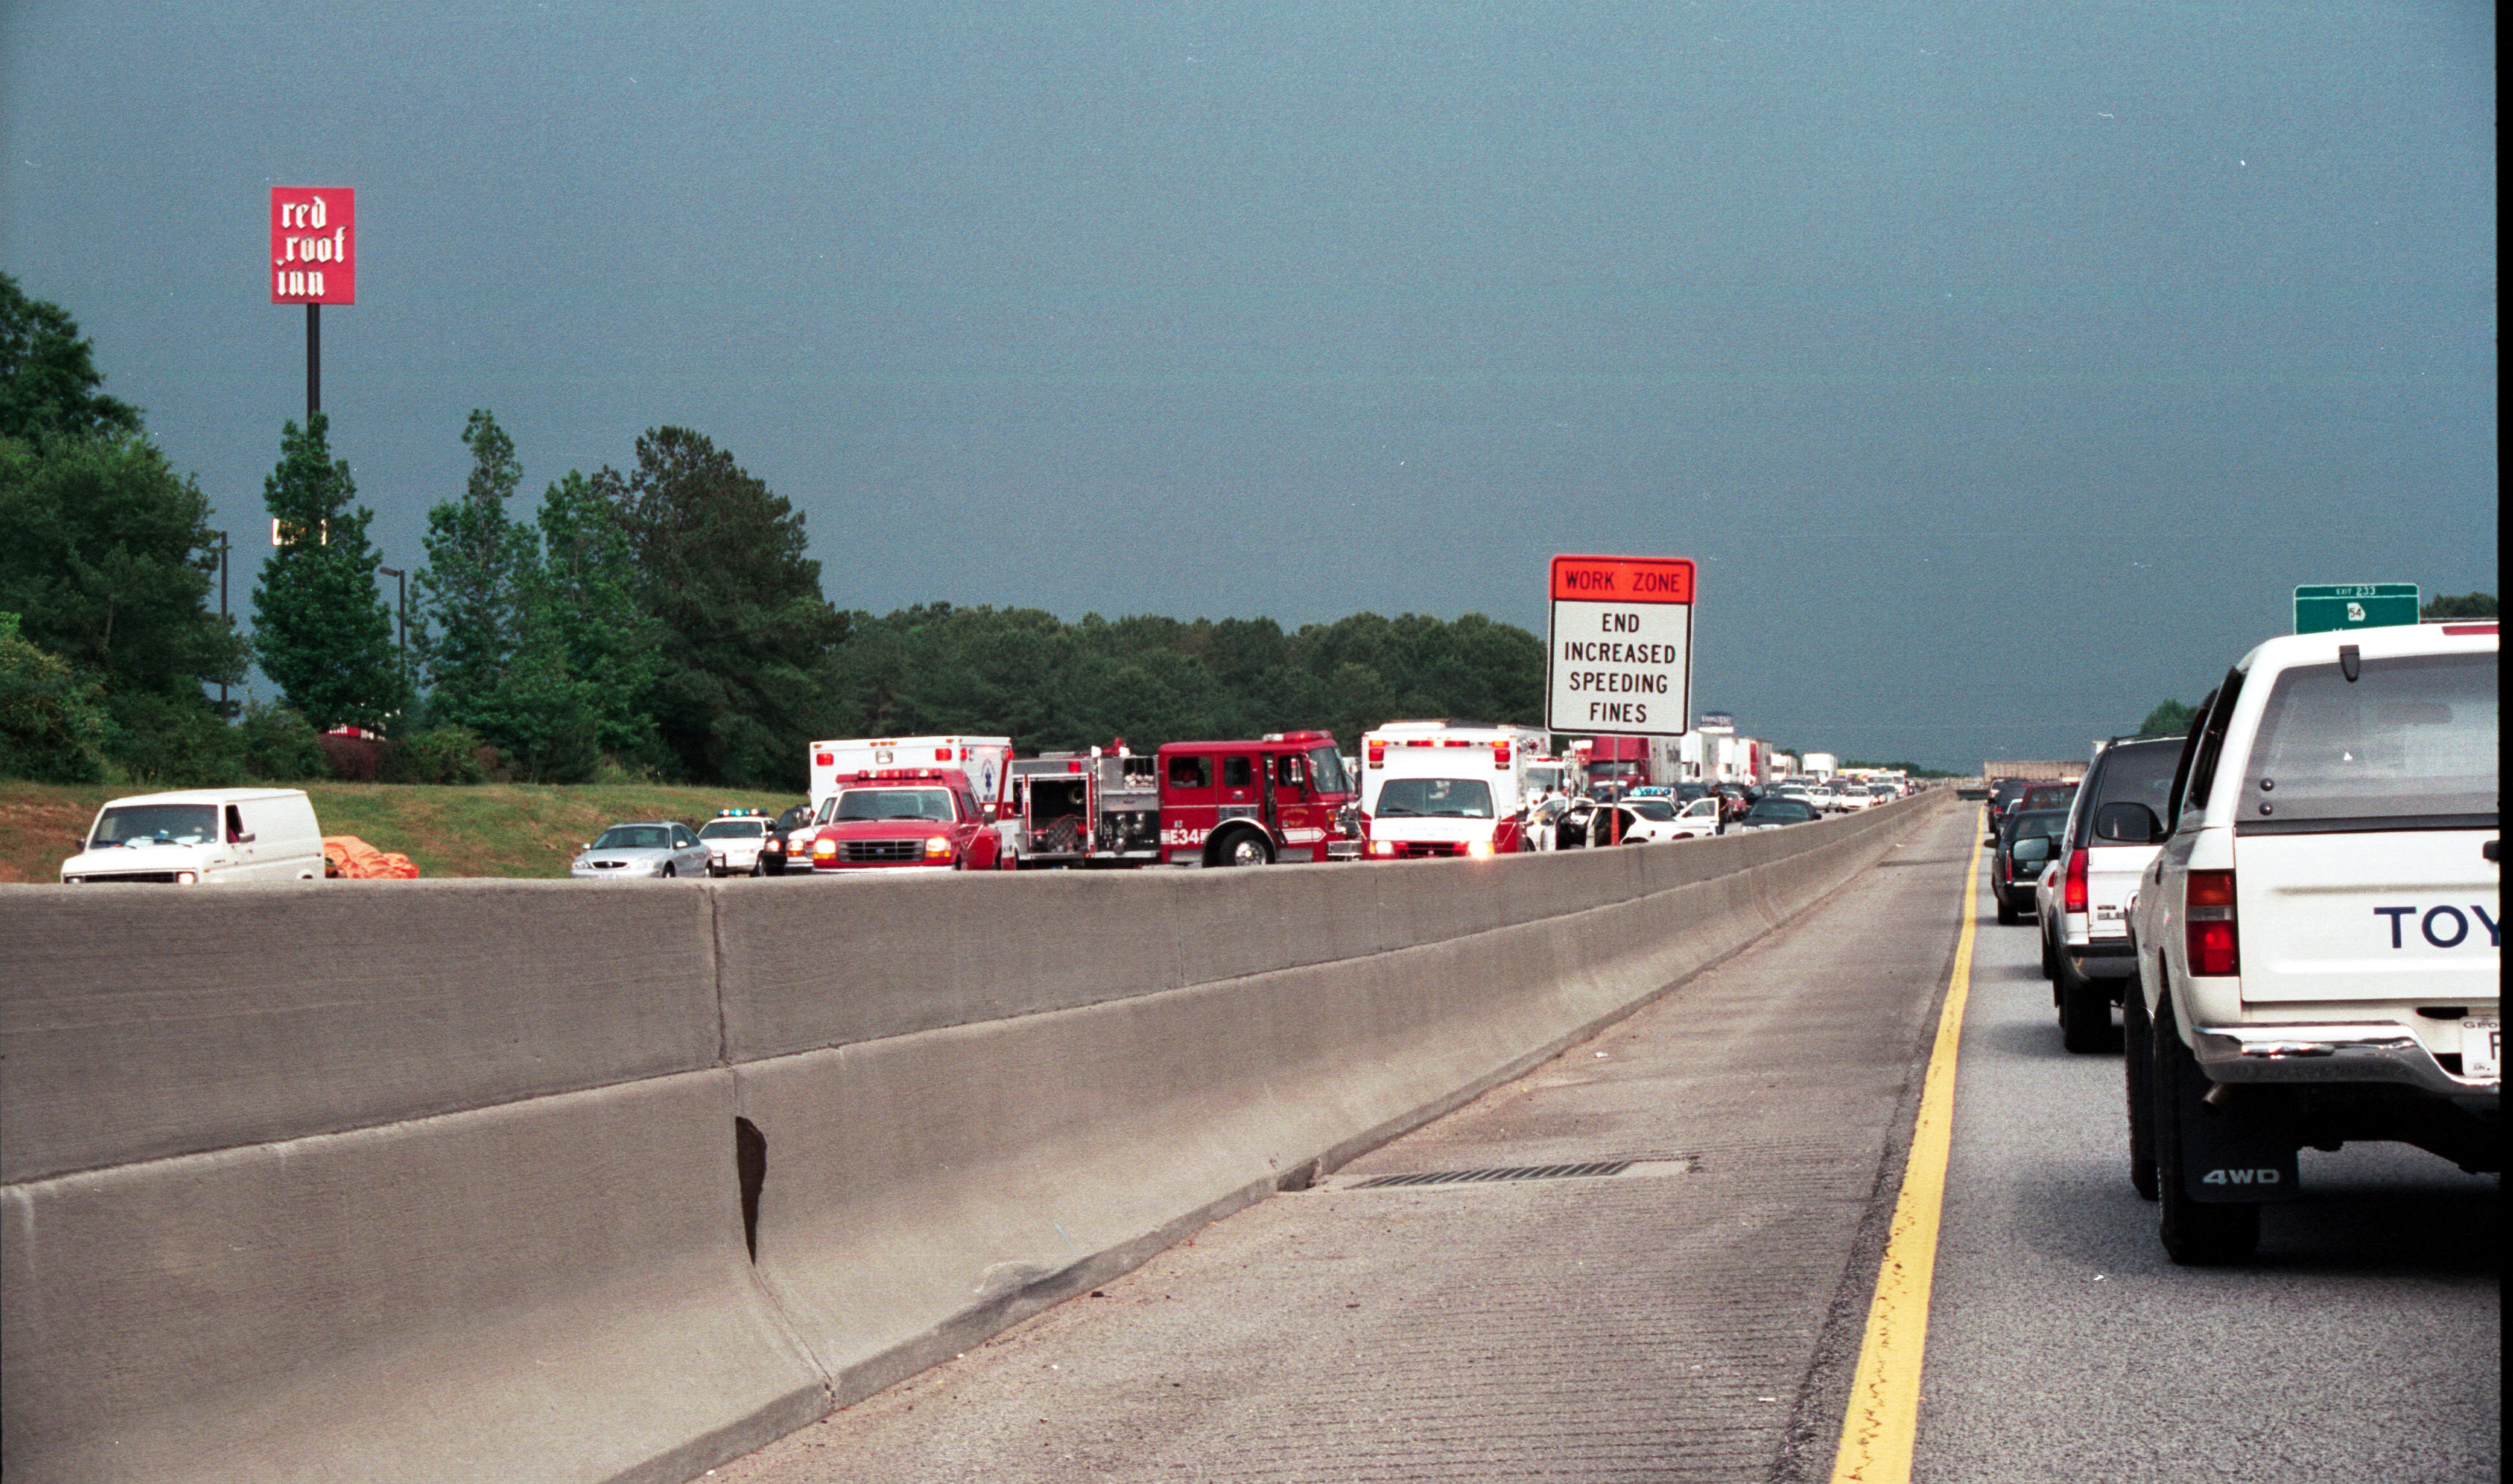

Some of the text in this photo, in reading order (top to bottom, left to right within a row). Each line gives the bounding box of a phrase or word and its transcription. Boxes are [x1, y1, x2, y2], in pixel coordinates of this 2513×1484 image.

[282, 195, 327, 229] red
[286, 226, 348, 263] roof
[275, 259, 325, 297] inn
[1565, 570, 1680, 592] WORK ZONE
[2335, 586, 2376, 597] EXIT 233
[1602, 613, 1640, 633] END
[2349, 608, 2362, 618] 54
[1565, 641, 1677, 664] INCREASED
[1569, 671, 1668, 694] SPEEDING
[1590, 702, 1647, 723] FINES
[1170, 828, 1200, 845] E34
[2203, 1169, 2280, 1185] 4WD
